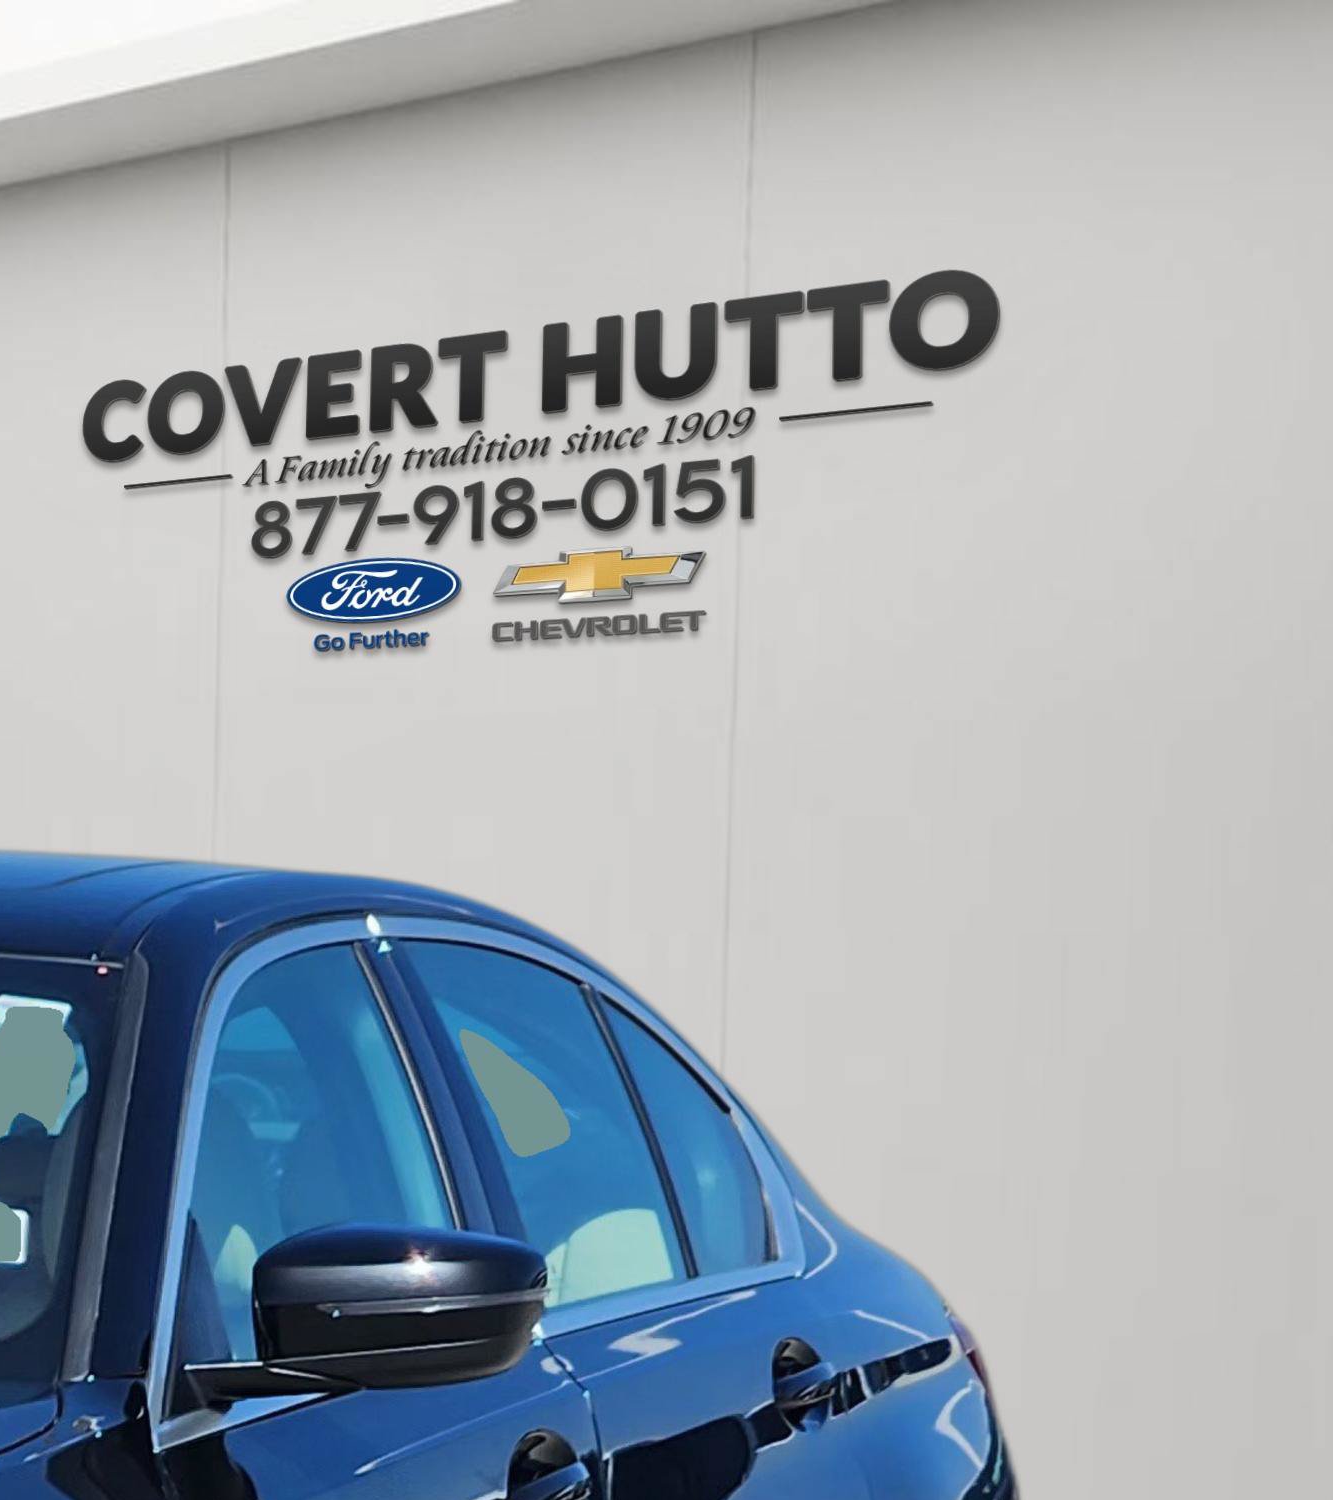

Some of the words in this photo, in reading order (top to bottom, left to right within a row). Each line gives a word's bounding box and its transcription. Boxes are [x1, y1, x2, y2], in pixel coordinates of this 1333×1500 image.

[82, 329, 509, 464] COVERT
[541, 269, 1001, 413] HUTTO
[242, 458, 270, 488] A
[274, 440, 393, 489] Family
[402, 430, 552, 473] tradition
[561, 424, 650, 456] since
[656, 406, 757, 446] 1909
[250, 454, 755, 559] 877-918-0151
[320, 569, 424, 612] Ford
[313, 632, 345, 653] Go
[348, 628, 430, 652] Further
[490, 610, 707, 643] CHEVROLET
